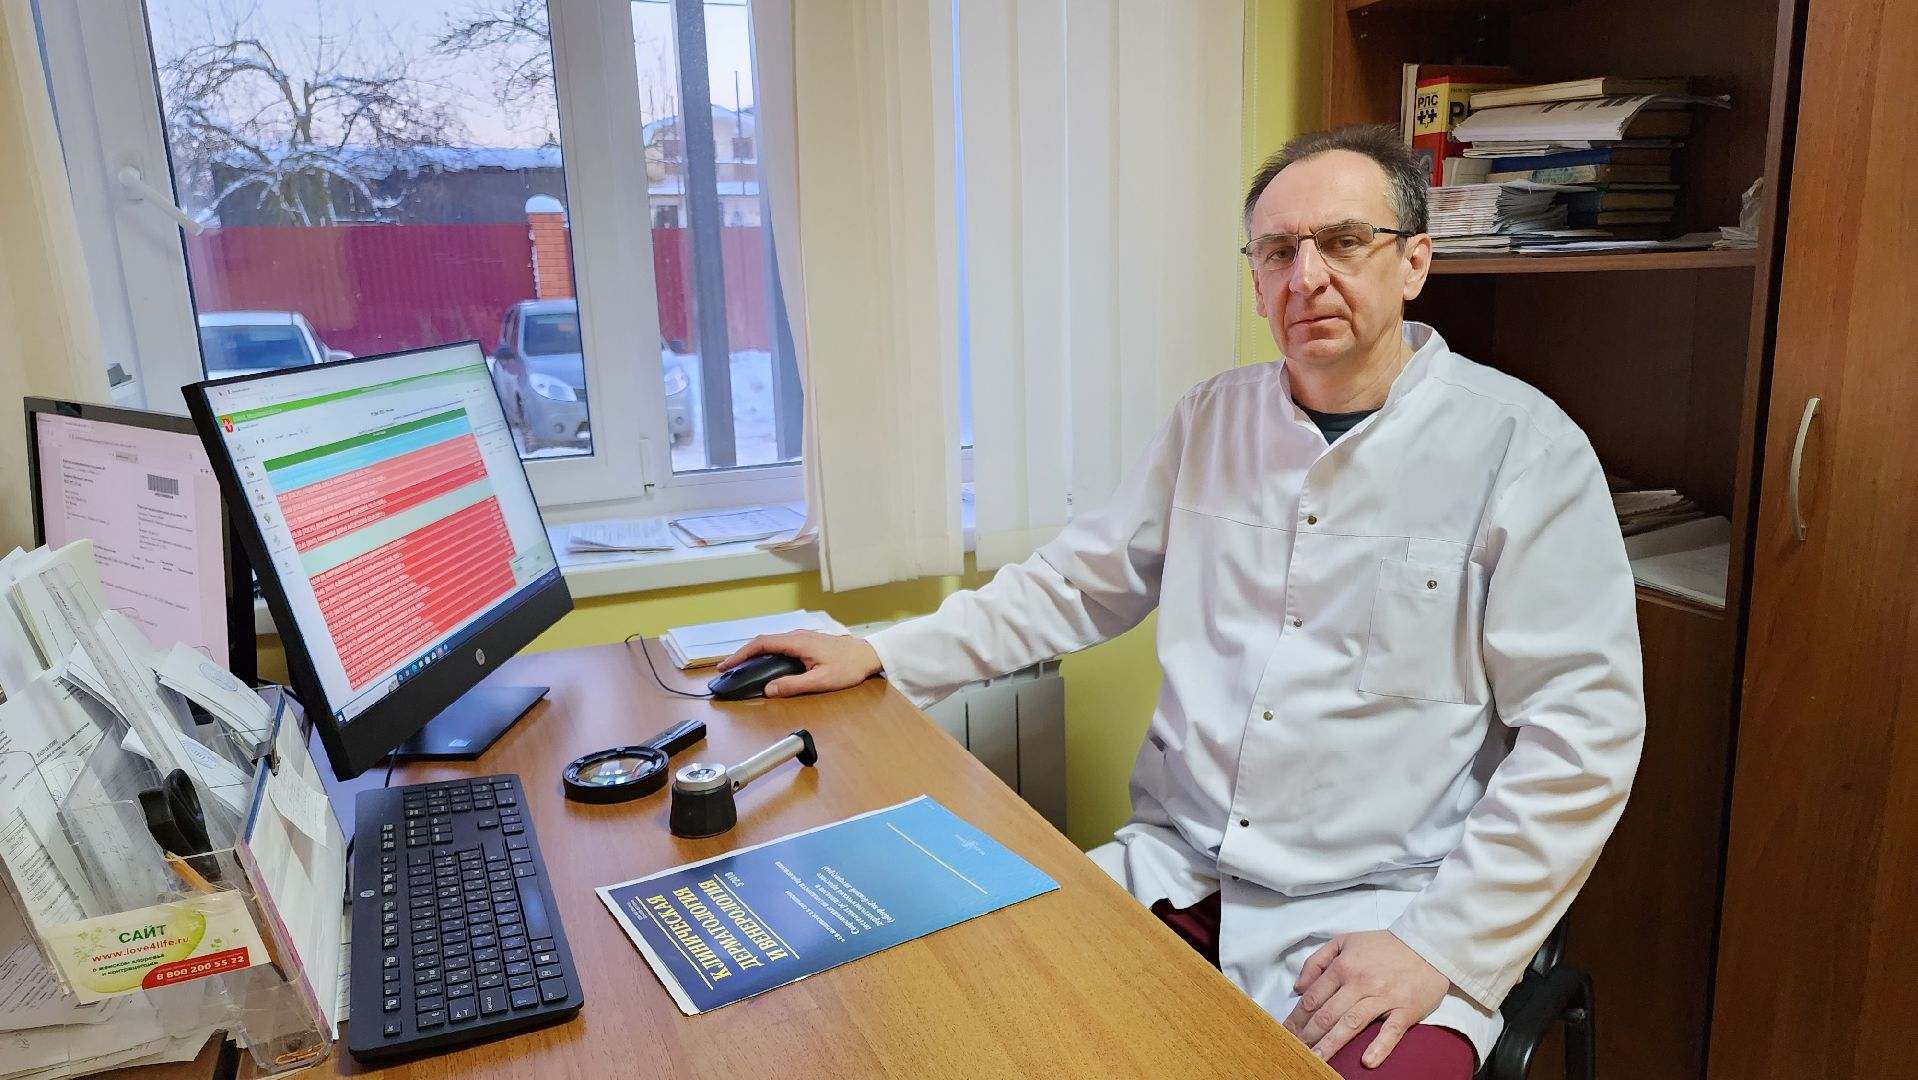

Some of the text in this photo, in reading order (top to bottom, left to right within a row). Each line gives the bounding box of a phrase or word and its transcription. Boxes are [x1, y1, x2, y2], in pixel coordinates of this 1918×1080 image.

[1417, 94, 1439, 108] РЛС
[672, 886, 765, 971] ДЕРМАТОЛОГИЯ
[698, 879, 789, 962] И ВЕНЕРОЛОГИЯ
[118, 925, 166, 944] САЙТ
[646, 895, 733, 982] КЛИНИЧЕСКАЯ
[92, 936, 189, 962] www.love4life.ru
[156, 955, 245, 981] 8 800 200 55 22
